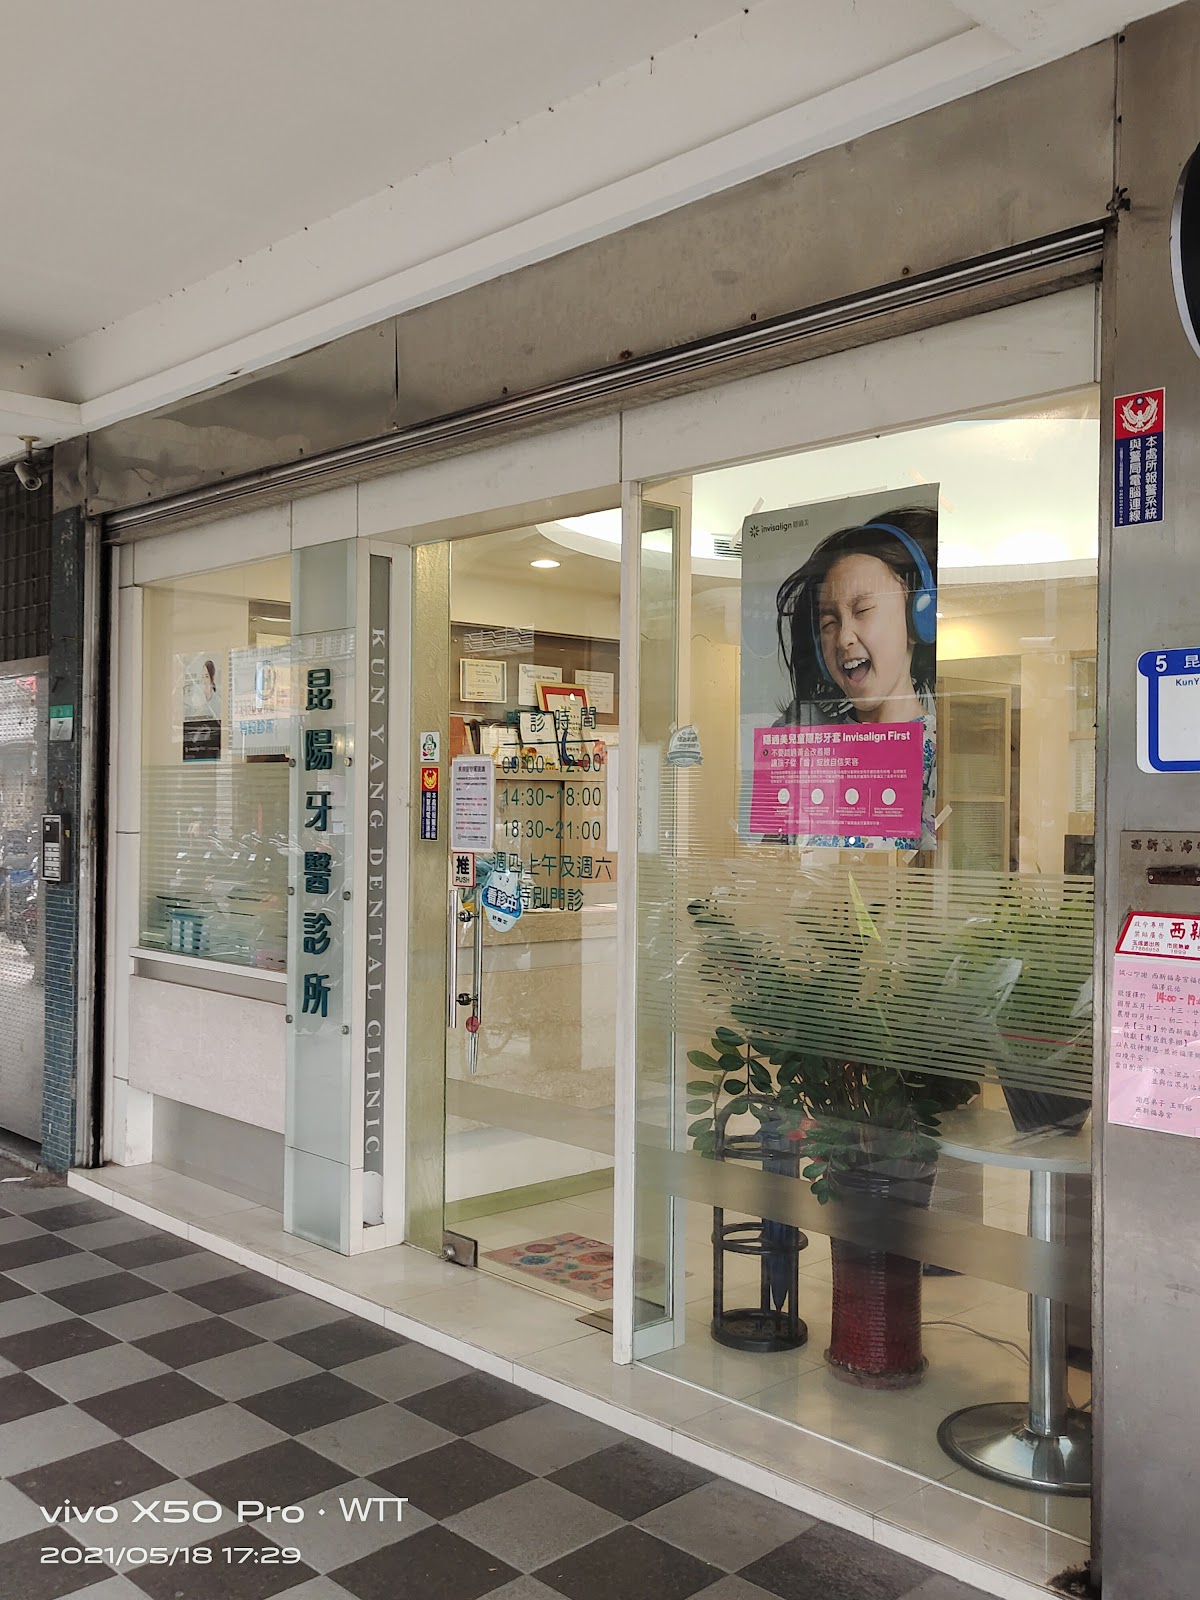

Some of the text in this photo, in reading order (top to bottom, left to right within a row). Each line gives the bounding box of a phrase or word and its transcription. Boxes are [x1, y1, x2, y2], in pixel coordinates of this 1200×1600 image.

[1129, 438, 1142, 522] 與警局電腦連線
[1145, 435, 1158, 520] 本處所報警系統
[761, 521, 792, 534] invisalign
[1155, 654, 1200, 673] 5 昆
[843, 731, 886, 744] Invisalign
[888, 730, 911, 741] First
[503, 788, 602, 807] 14:30~18:00
[503, 820, 602, 841] 18:30~21:00
[302, 668, 333, 1017] 昆陽牙醫診所
[456, 855, 470, 875] 推
[493, 852, 612, 880] 週四上午及週六
[455, 875, 471, 884] PUSH
[365, 628, 386, 1154] KUN YANG DENTAL CLINIC
[487, 886, 518, 913] 看診中
[1156, 992, 1177, 1003] 14:00
